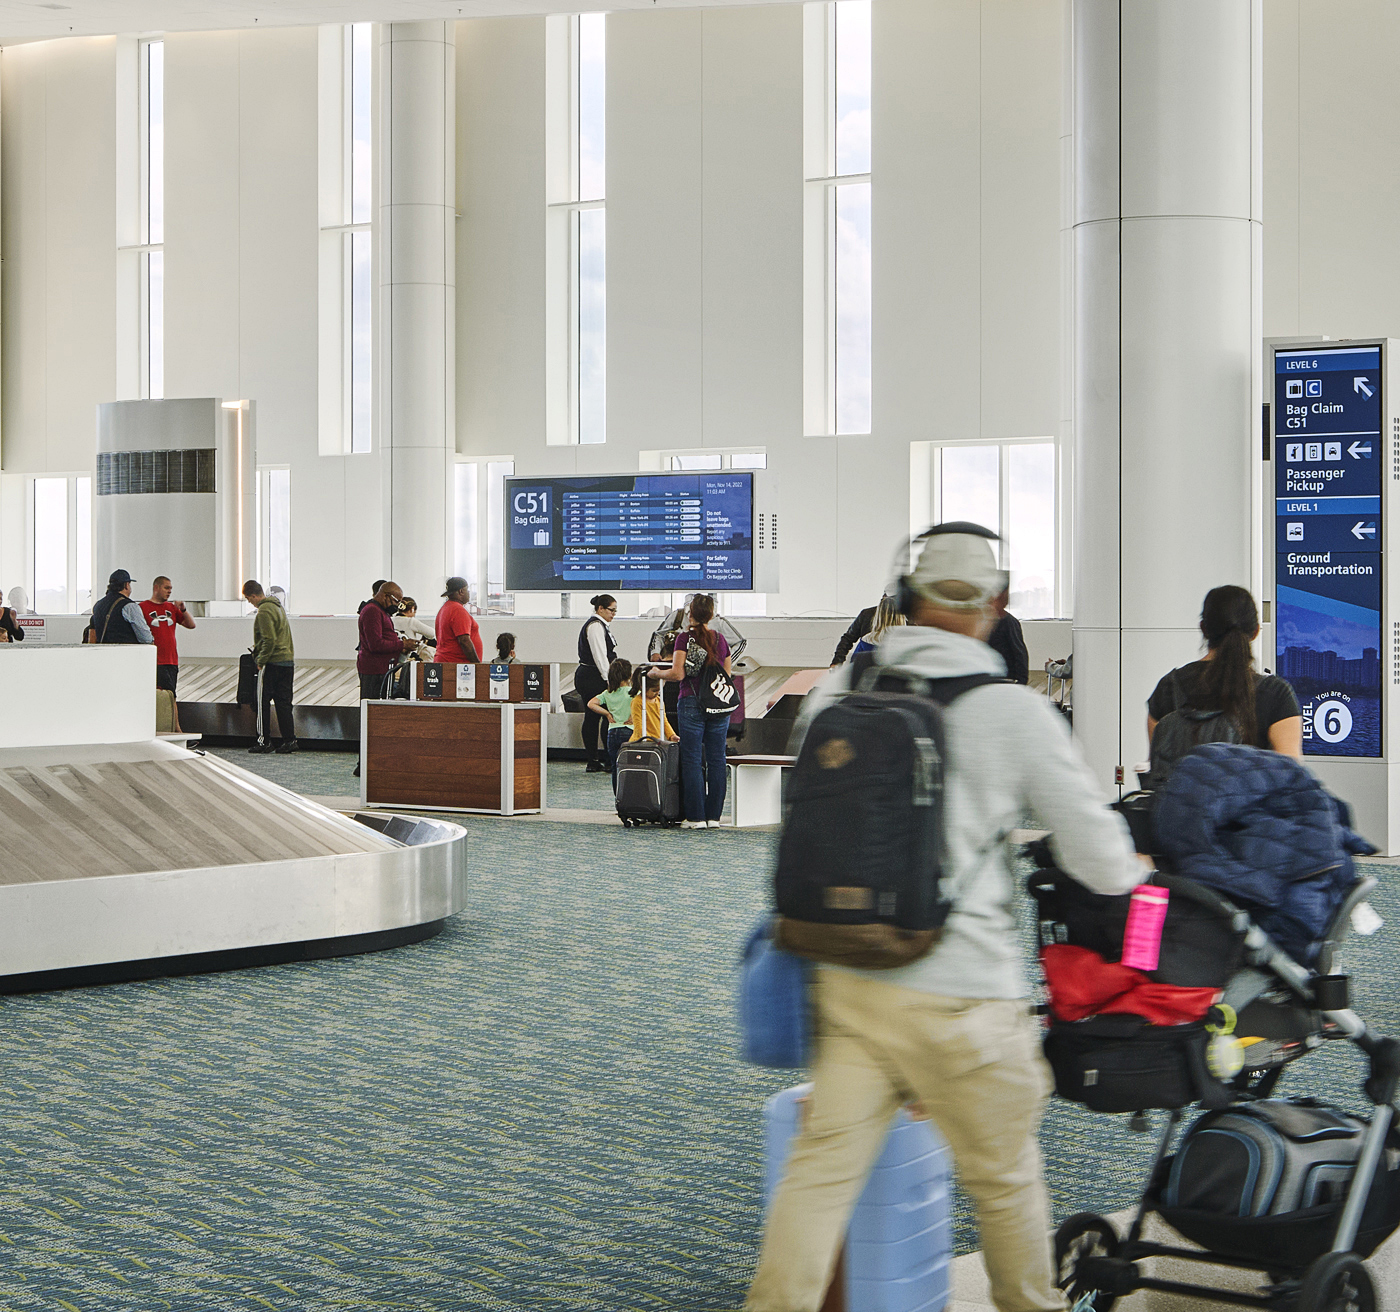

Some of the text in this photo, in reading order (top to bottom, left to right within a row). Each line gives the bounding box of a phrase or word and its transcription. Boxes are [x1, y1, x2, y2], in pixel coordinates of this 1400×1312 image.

[1286, 360, 1318, 369] LEVEL 6
[1309, 384, 1318, 394] C
[1286, 402, 1344, 416] Bag Claim
[1286, 418, 1307, 428] C51
[1286, 468, 1345, 482] Passenger
[1286, 480, 1324, 493] Pickup
[514, 492, 547, 513] C51
[1287, 503, 1318, 512] LEVEL 1
[514, 515, 549, 526] Bag Claim
[1287, 552, 1331, 564] Ground
[1287, 564, 1373, 577] Transportation
[1315, 690, 1351, 703] You are on
[1303, 702, 1313, 739] LEVEL
[1324, 708, 1341, 736] 6
